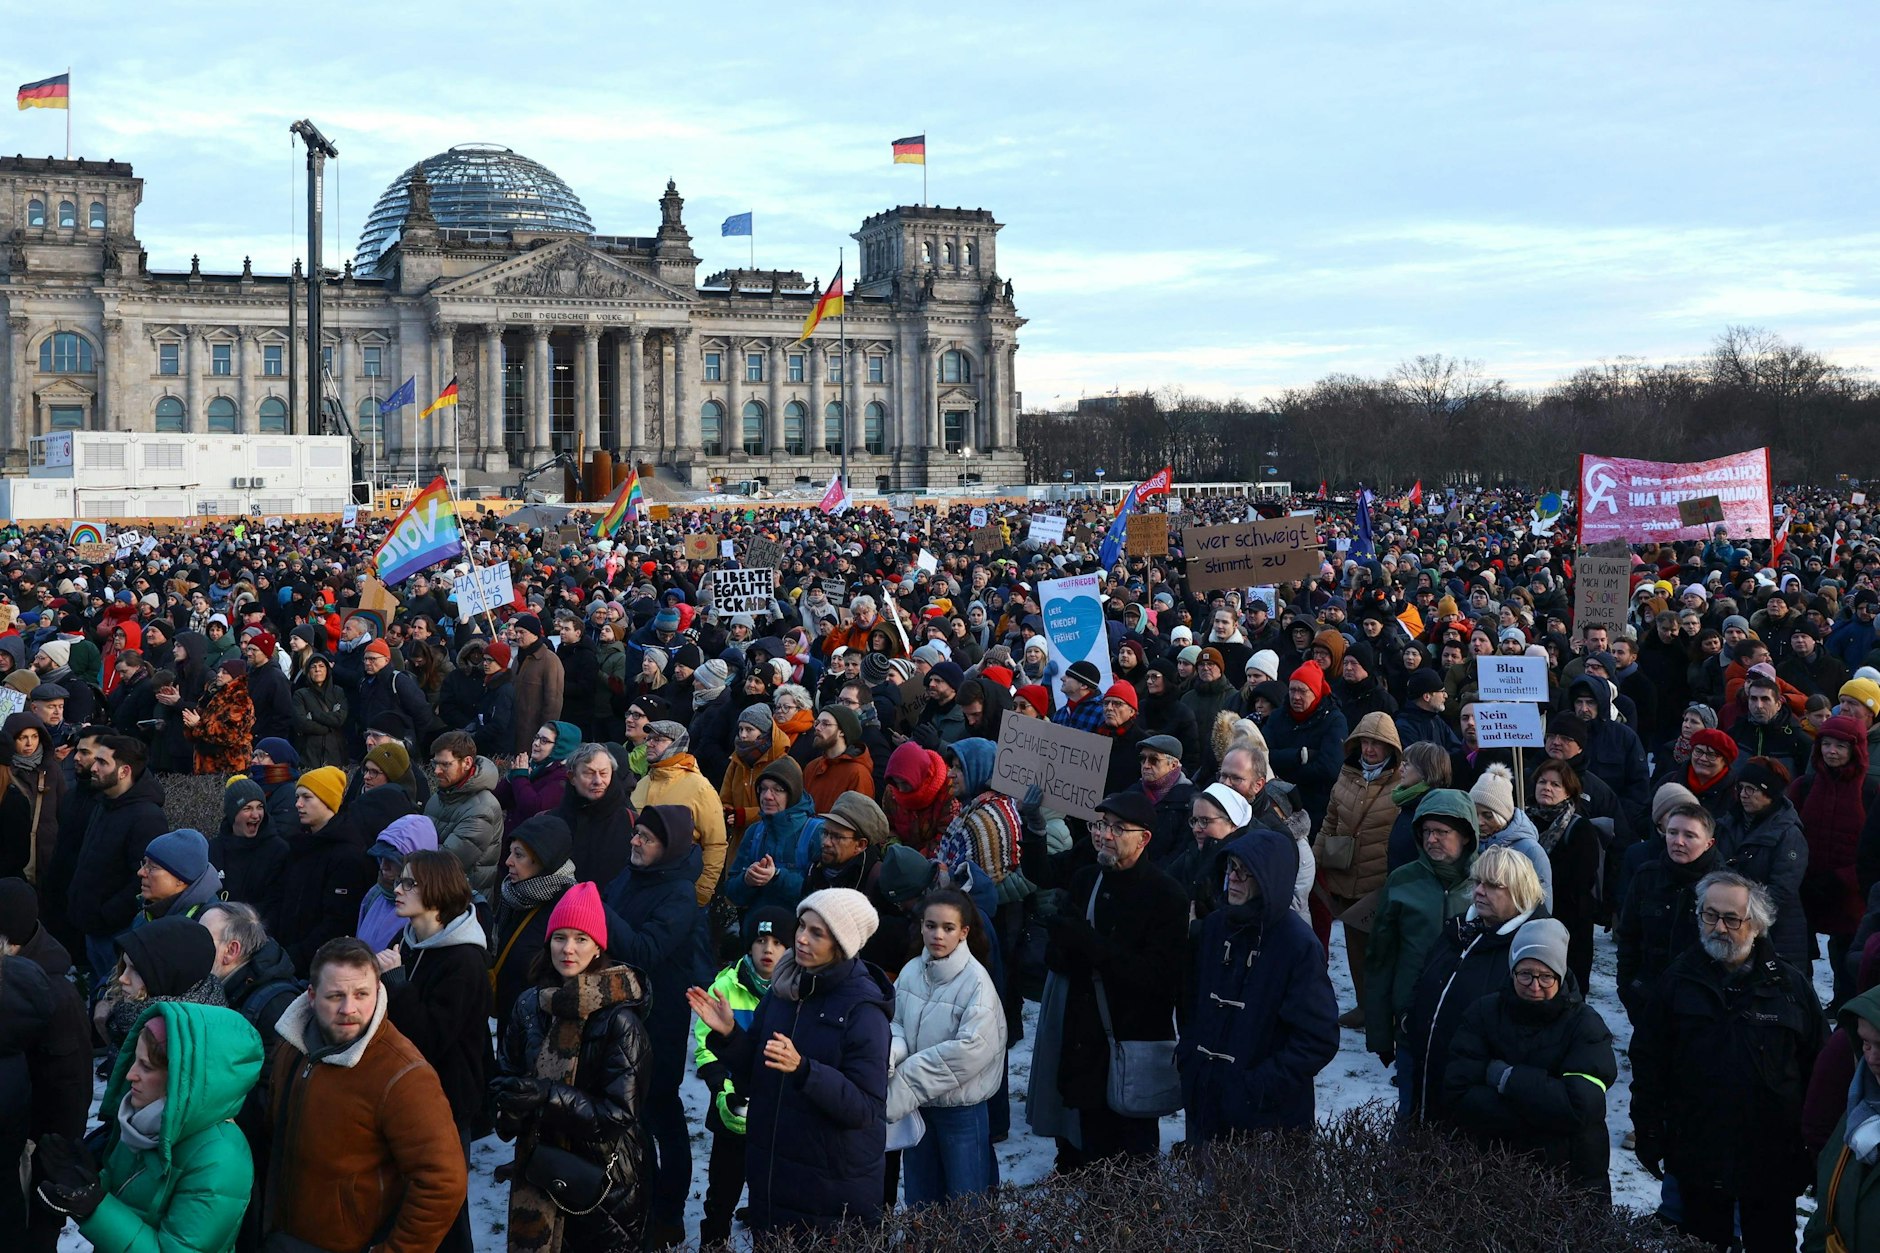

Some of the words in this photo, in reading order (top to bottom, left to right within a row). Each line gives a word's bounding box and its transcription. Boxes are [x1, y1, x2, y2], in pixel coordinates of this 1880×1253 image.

[539, 312, 590, 320] DEUTSCHEN
[596, 313, 623, 321] VOLKE
[121, 532, 137, 546] NO
[1196, 535, 1230, 550] wer
[1235, 523, 1309, 549] schweigt
[1205, 554, 1254, 574] stimmt
[1580, 563, 1593, 574] ICH
[1598, 562, 1629, 575] KÖNNTE
[1582, 577, 1599, 588] MICH
[1603, 579, 1619, 589] UM
[1585, 606, 1615, 618] DINGE
[1050, 616, 1077, 629] FRIEDEN
[1053, 631, 1080, 644] FREIHEIT
[1496, 663, 1524, 673] Blau
[1499, 676, 1522, 684] wählt
[1504, 686, 1538, 695] nicht!!!!
[1479, 710, 1508, 720] Nein
[1494, 722, 1518, 730] Hass
[1483, 732, 1500, 740] und
[1503, 732, 1534, 740] Hetze!
[1004, 714, 1104, 773] SCHWESTERN
[997, 748, 1043, 787] GEGEN
[1043, 762, 1097, 810] RECHTS
